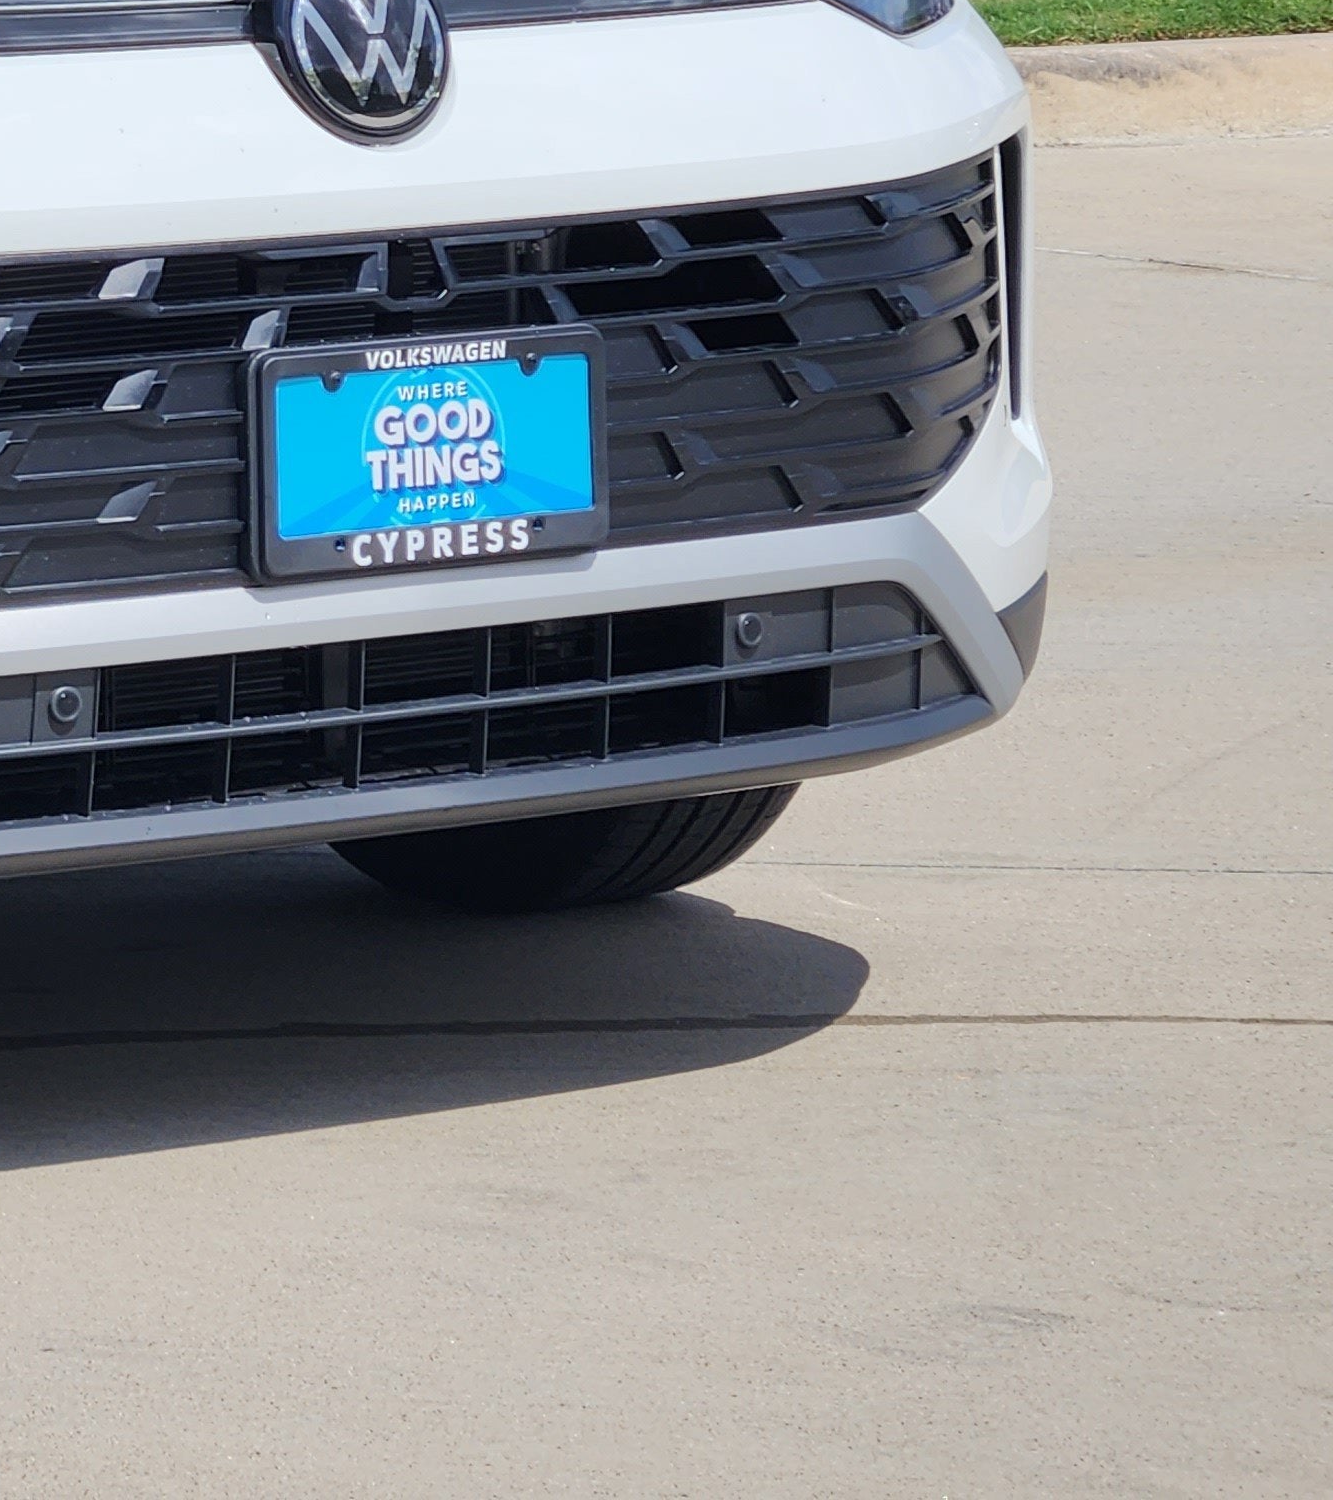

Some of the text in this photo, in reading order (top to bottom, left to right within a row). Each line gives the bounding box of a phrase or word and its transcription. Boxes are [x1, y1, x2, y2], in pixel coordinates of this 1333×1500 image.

[365, 340, 507, 371] VOLKSWAGEN
[397, 381, 469, 402] WHERE
[374, 399, 492, 447] GOOD
[365, 440, 503, 491] THINGS
[397, 491, 477, 513] HAPPEN
[351, 518, 530, 568] CYPRESS
